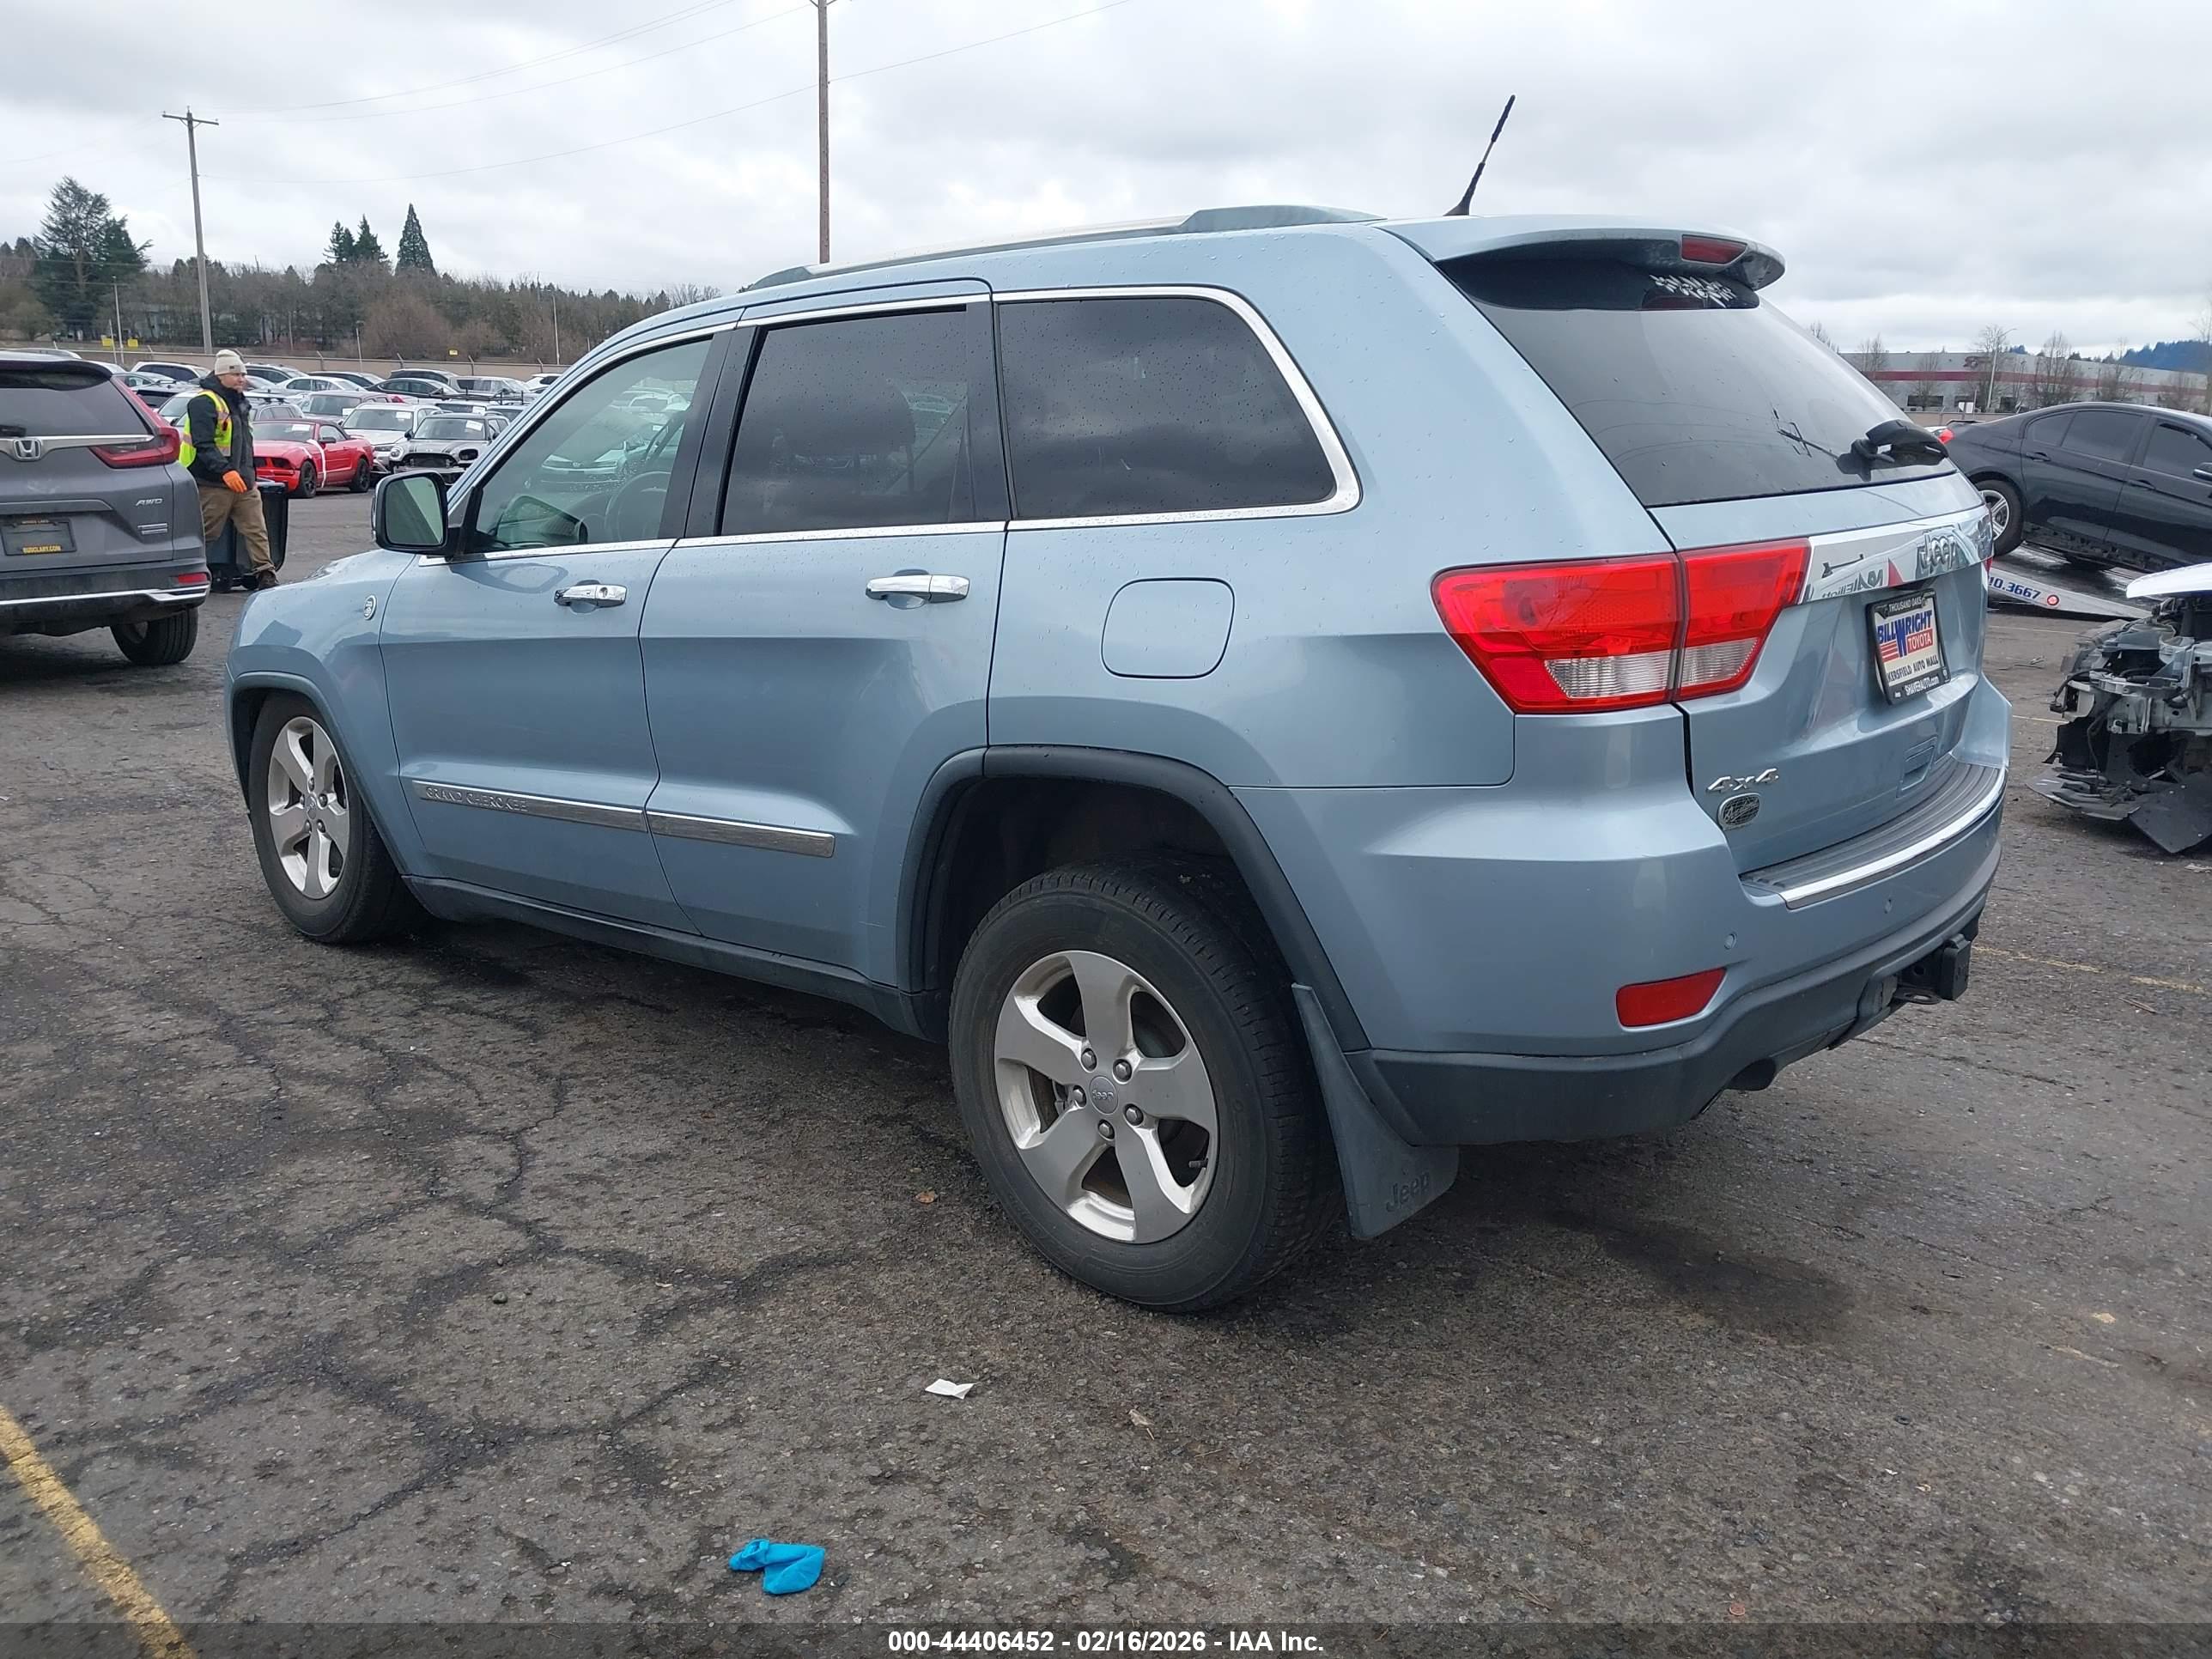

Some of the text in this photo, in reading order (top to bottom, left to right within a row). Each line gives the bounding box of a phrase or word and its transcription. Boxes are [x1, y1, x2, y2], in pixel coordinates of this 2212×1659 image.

[136, 498, 163, 507] AWD
[1920, 531, 1956, 569] Jeep
[1889, 599, 1911, 612] THOUSAND
[1877, 611, 1932, 658] BILL WRIGHT
[1908, 632, 1932, 650] TOYOTA
[1887, 654, 1939, 682] KERSFIELD AUTO MALL
[1707, 768, 1779, 791] 4x4
[426, 787, 528, 812] GRAND CHEROKEE
